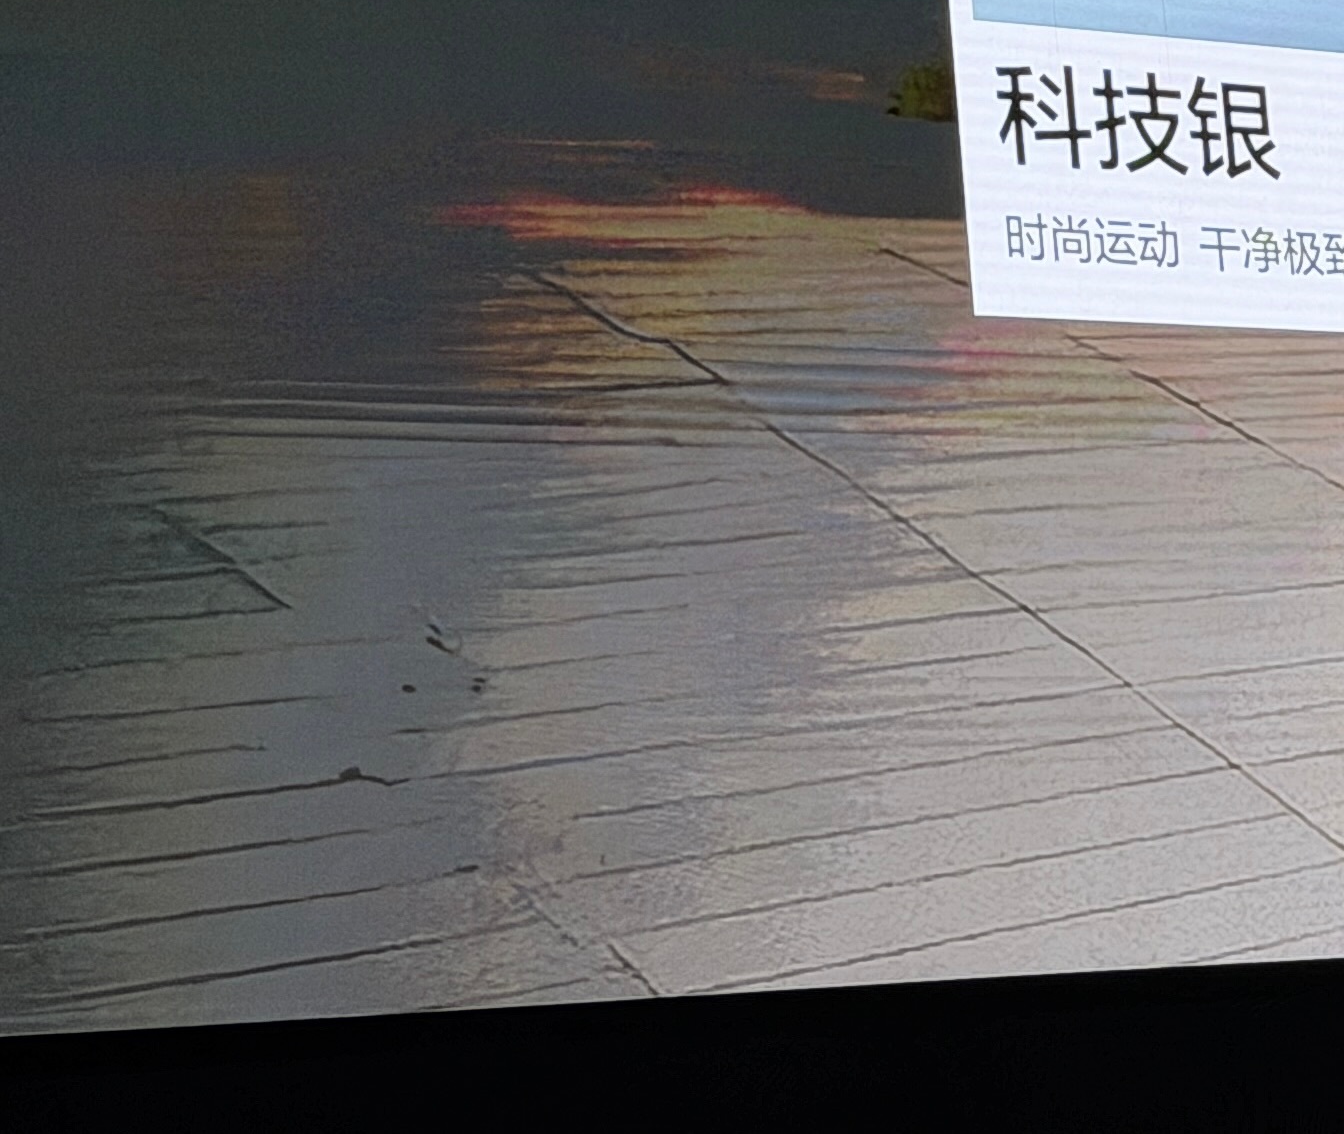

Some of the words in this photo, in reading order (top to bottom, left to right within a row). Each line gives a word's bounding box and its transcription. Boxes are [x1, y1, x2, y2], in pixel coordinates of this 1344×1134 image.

[996, 65, 1281, 180] 科技银
[1005, 213, 1180, 268] 时尚运动
